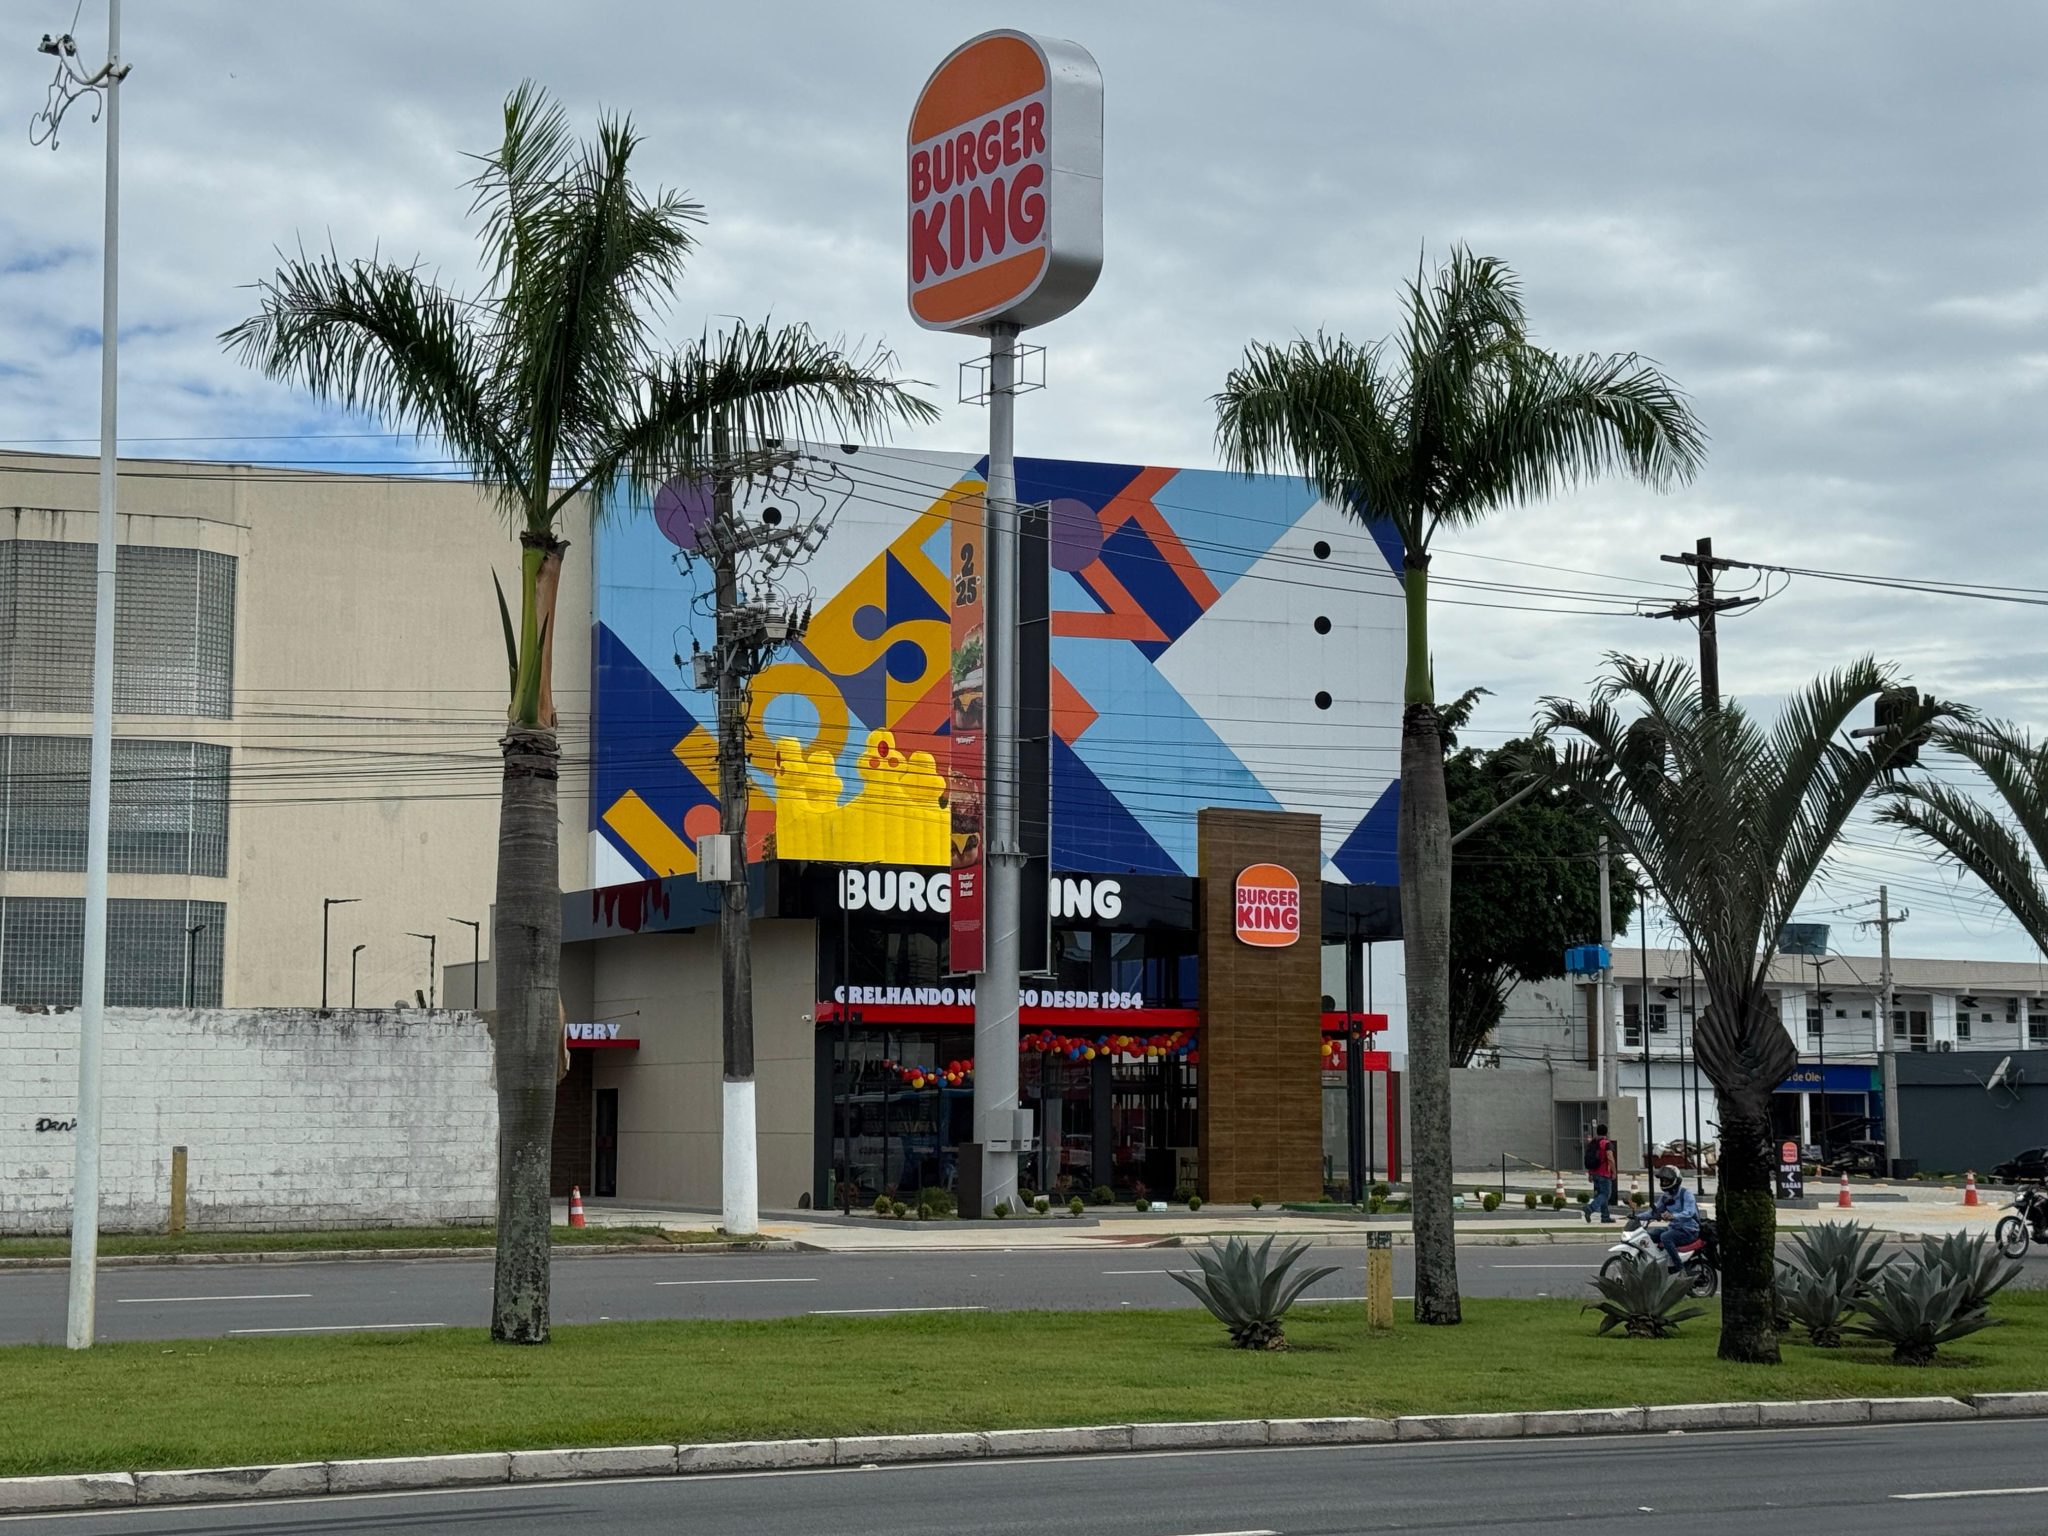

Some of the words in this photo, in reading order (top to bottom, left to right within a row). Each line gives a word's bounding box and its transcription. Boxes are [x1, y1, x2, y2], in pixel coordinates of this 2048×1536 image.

[911, 101, 1046, 204] BURGER
[912, 163, 1046, 284] KING
[961, 543, 974, 577] 2
[839, 869, 951, 914] BURG
[1050, 877, 1122, 919] ING
[1237, 888, 1298, 907] BURGER
[1237, 905, 1299, 930] KING
[834, 985, 955, 1006] GRELHANDO
[1041, 990, 1099, 1009] DESDE
[1101, 990, 1144, 1009] 1954
[568, 1023, 621, 1040] VERY
[1792, 1072, 1804, 1081] de
